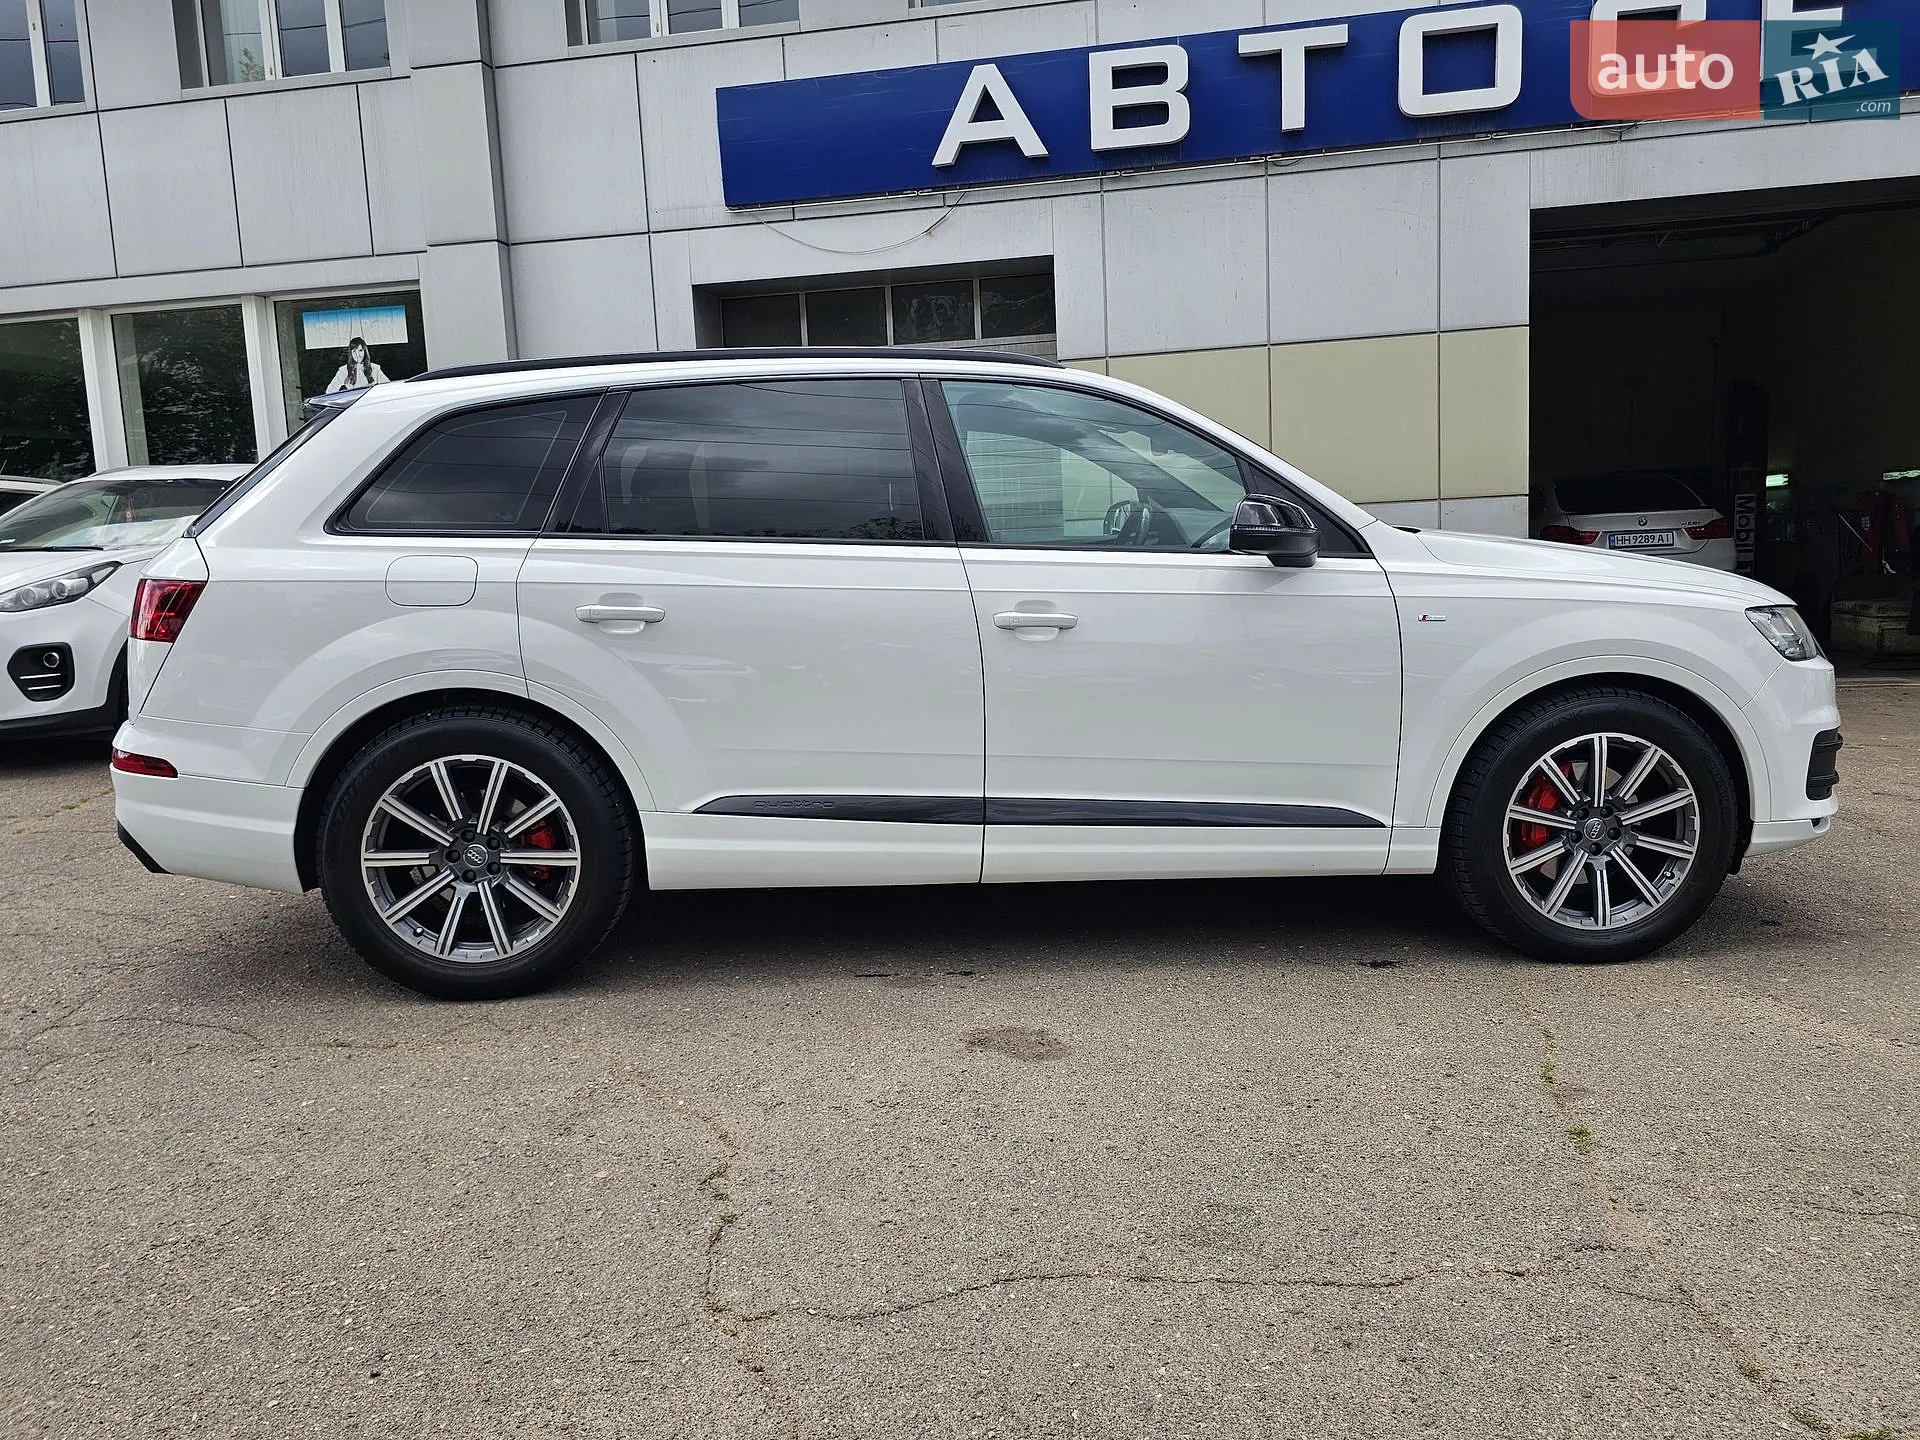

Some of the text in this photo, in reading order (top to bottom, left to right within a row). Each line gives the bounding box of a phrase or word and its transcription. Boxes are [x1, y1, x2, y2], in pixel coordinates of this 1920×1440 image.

[1616, 536, 1631, 545] HH
[1632, 534, 1655, 544] 9289
[754, 799, 834, 810] quattro
